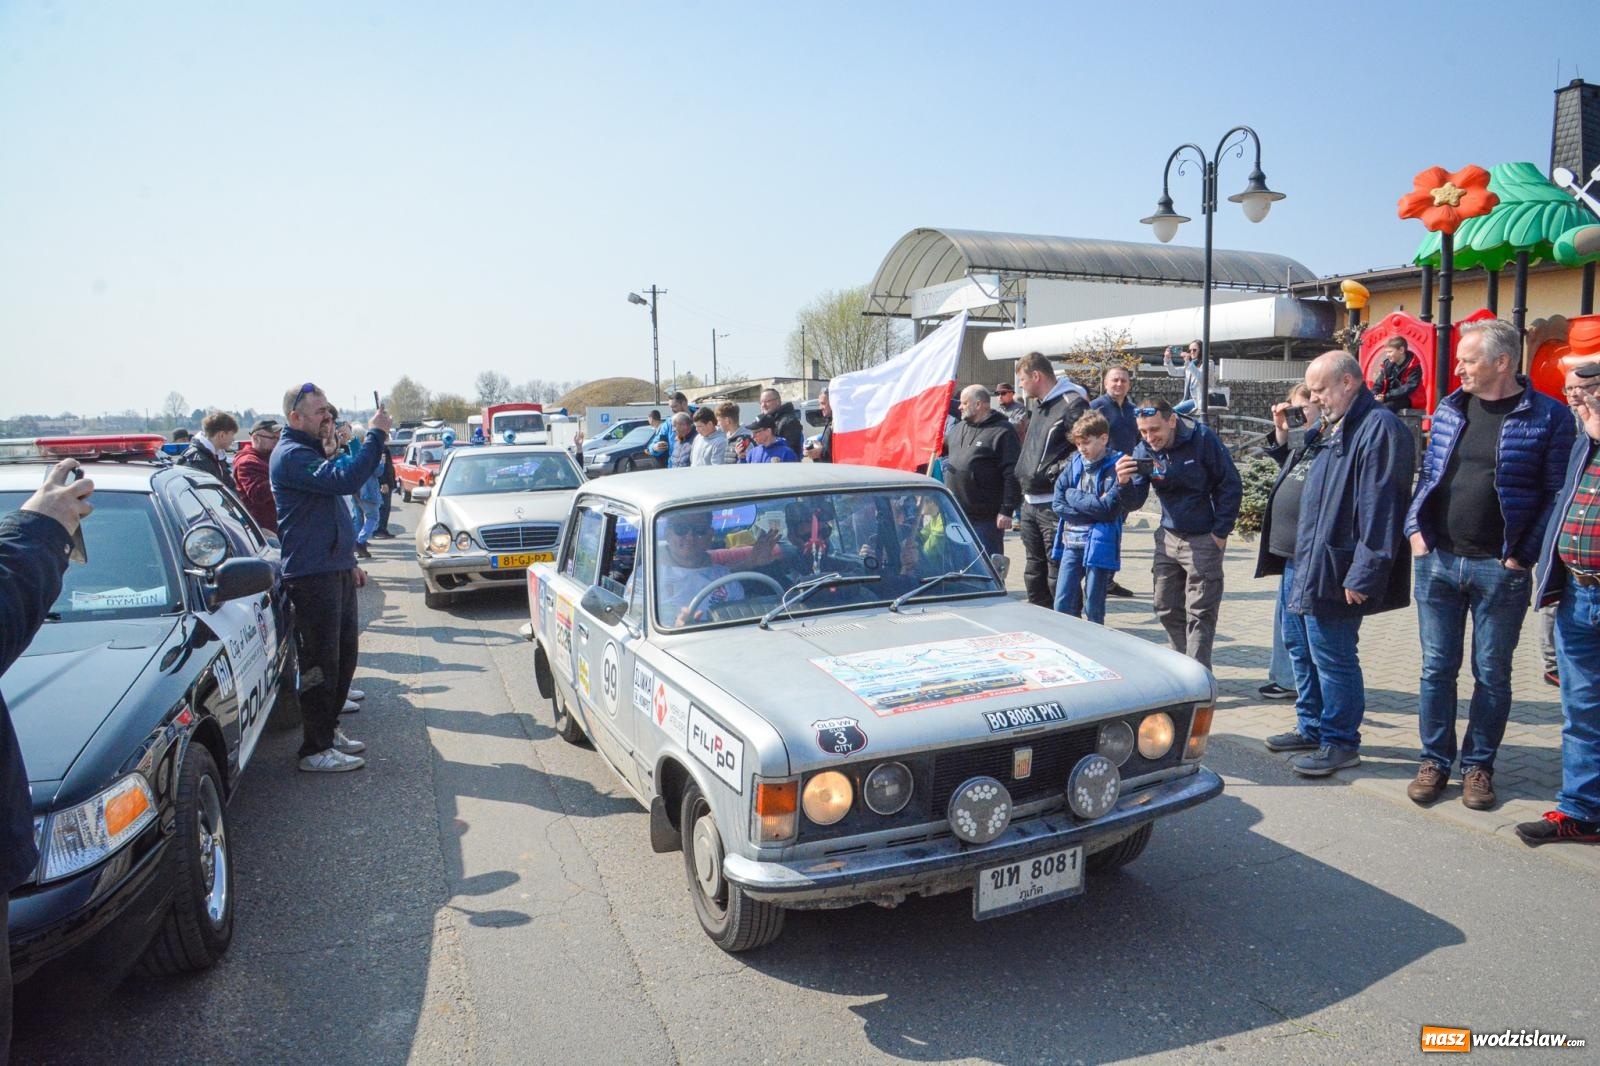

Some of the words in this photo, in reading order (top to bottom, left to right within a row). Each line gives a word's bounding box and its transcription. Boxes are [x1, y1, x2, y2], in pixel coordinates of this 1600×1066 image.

[951, 525, 968, 542] T
[603, 657, 617, 701] 99
[986, 712, 1008, 729] BO
[1007, 707, 1041, 725] 8081
[1037, 702, 1063, 721] PKT
[834, 731, 848, 745] 3
[834, 743, 853, 753] CITY
[1030, 849, 1078, 880] 8081
